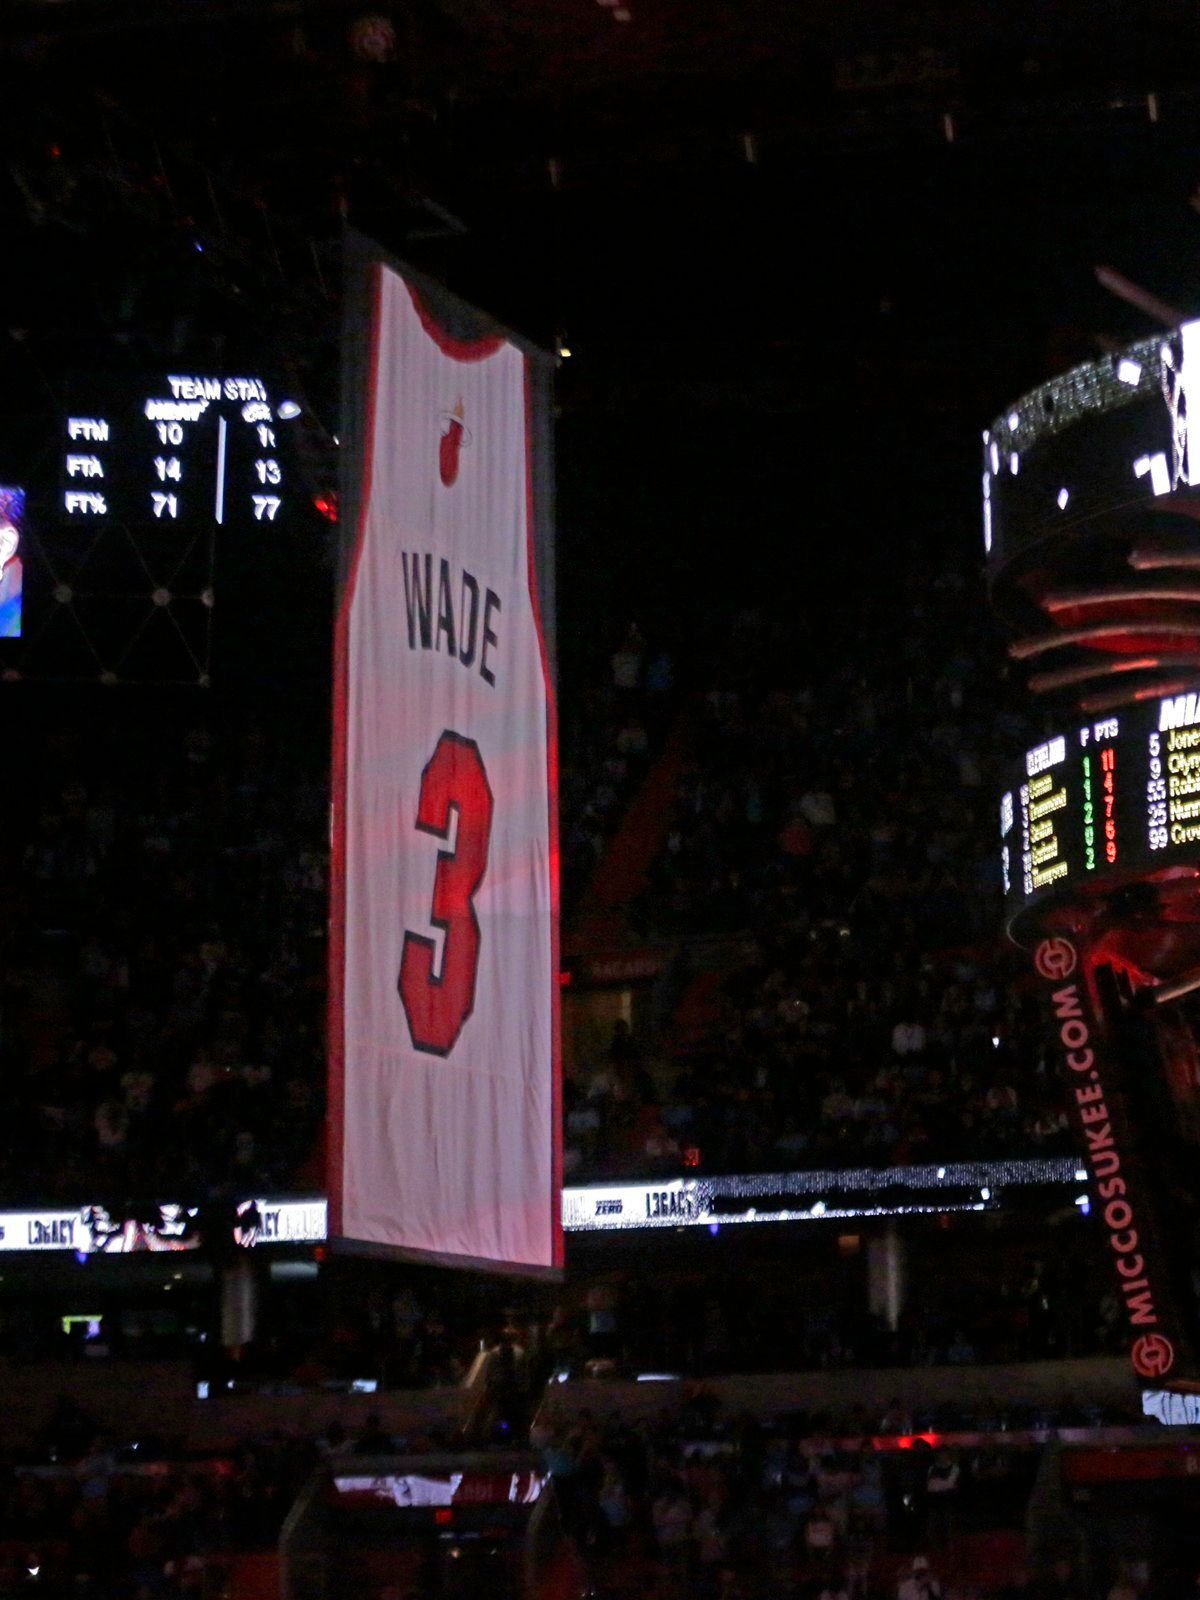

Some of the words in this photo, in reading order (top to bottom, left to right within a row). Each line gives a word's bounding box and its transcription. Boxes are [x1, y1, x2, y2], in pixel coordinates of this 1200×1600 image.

[167, 375, 221, 400] TEAM
[68, 417, 109, 441] FTM
[154, 420, 183, 445] 10
[67, 454, 104, 478] FTA
[154, 456, 181, 482] 14
[255, 459, 281, 484] 13
[65, 491, 107, 514] FT%
[151, 492, 177, 518] 71
[252, 495, 281, 520] 77
[401, 551, 501, 689] WADE
[1080, 728, 1090, 747] F
[1094, 718, 1119, 743] PTS
[397, 728, 496, 1058] 3
[1052, 984, 1158, 1325] MICCOSUKEE.COM
